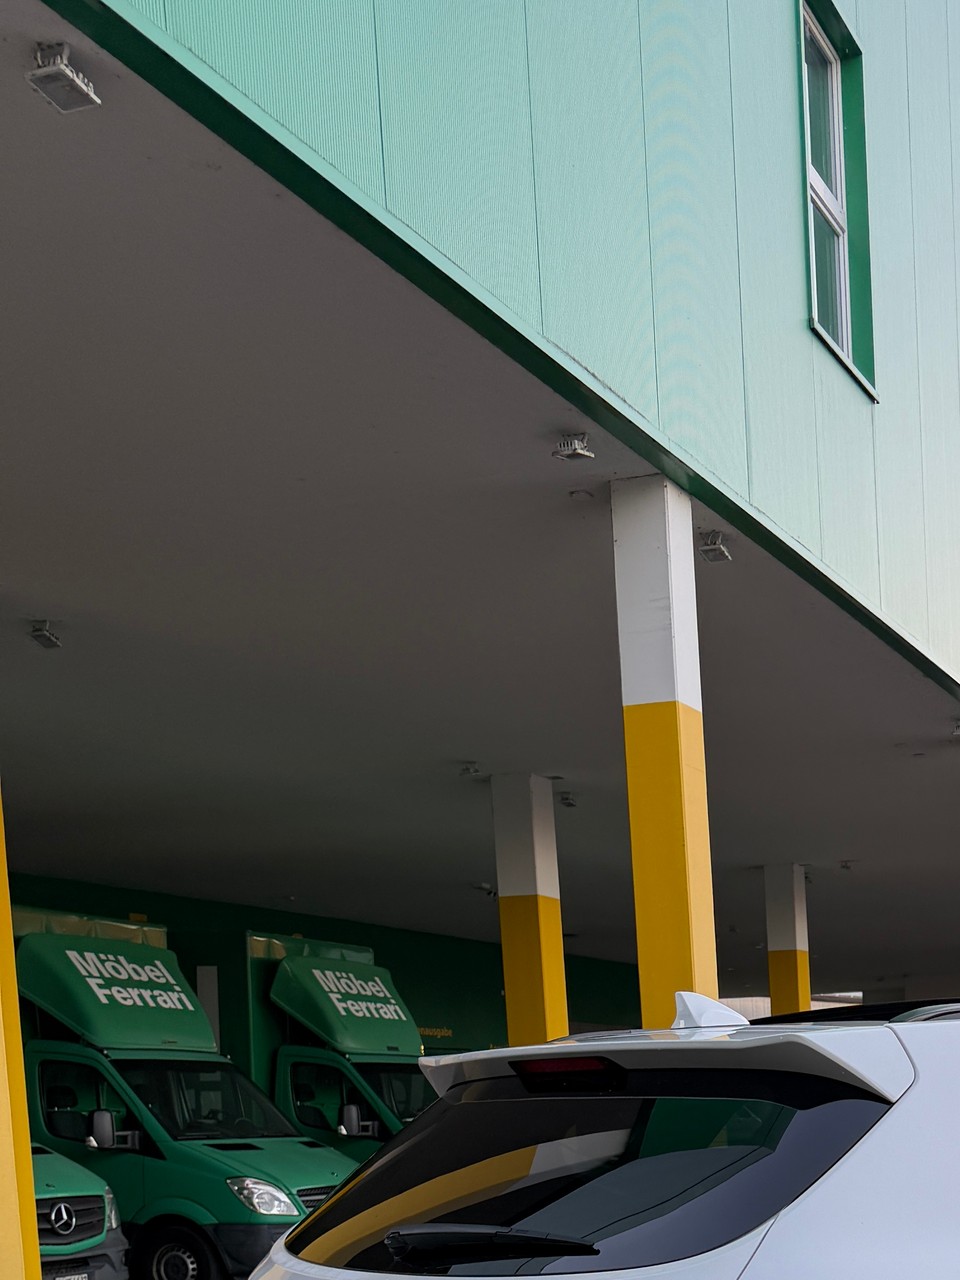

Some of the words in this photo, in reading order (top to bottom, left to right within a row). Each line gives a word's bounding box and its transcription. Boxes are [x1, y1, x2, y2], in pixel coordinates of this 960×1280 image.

[65, 950, 177, 985] Möbel
[85, 977, 195, 1011] Ferrari
[312, 969, 392, 998] Möbel
[328, 993, 407, 1021] Ferrari
